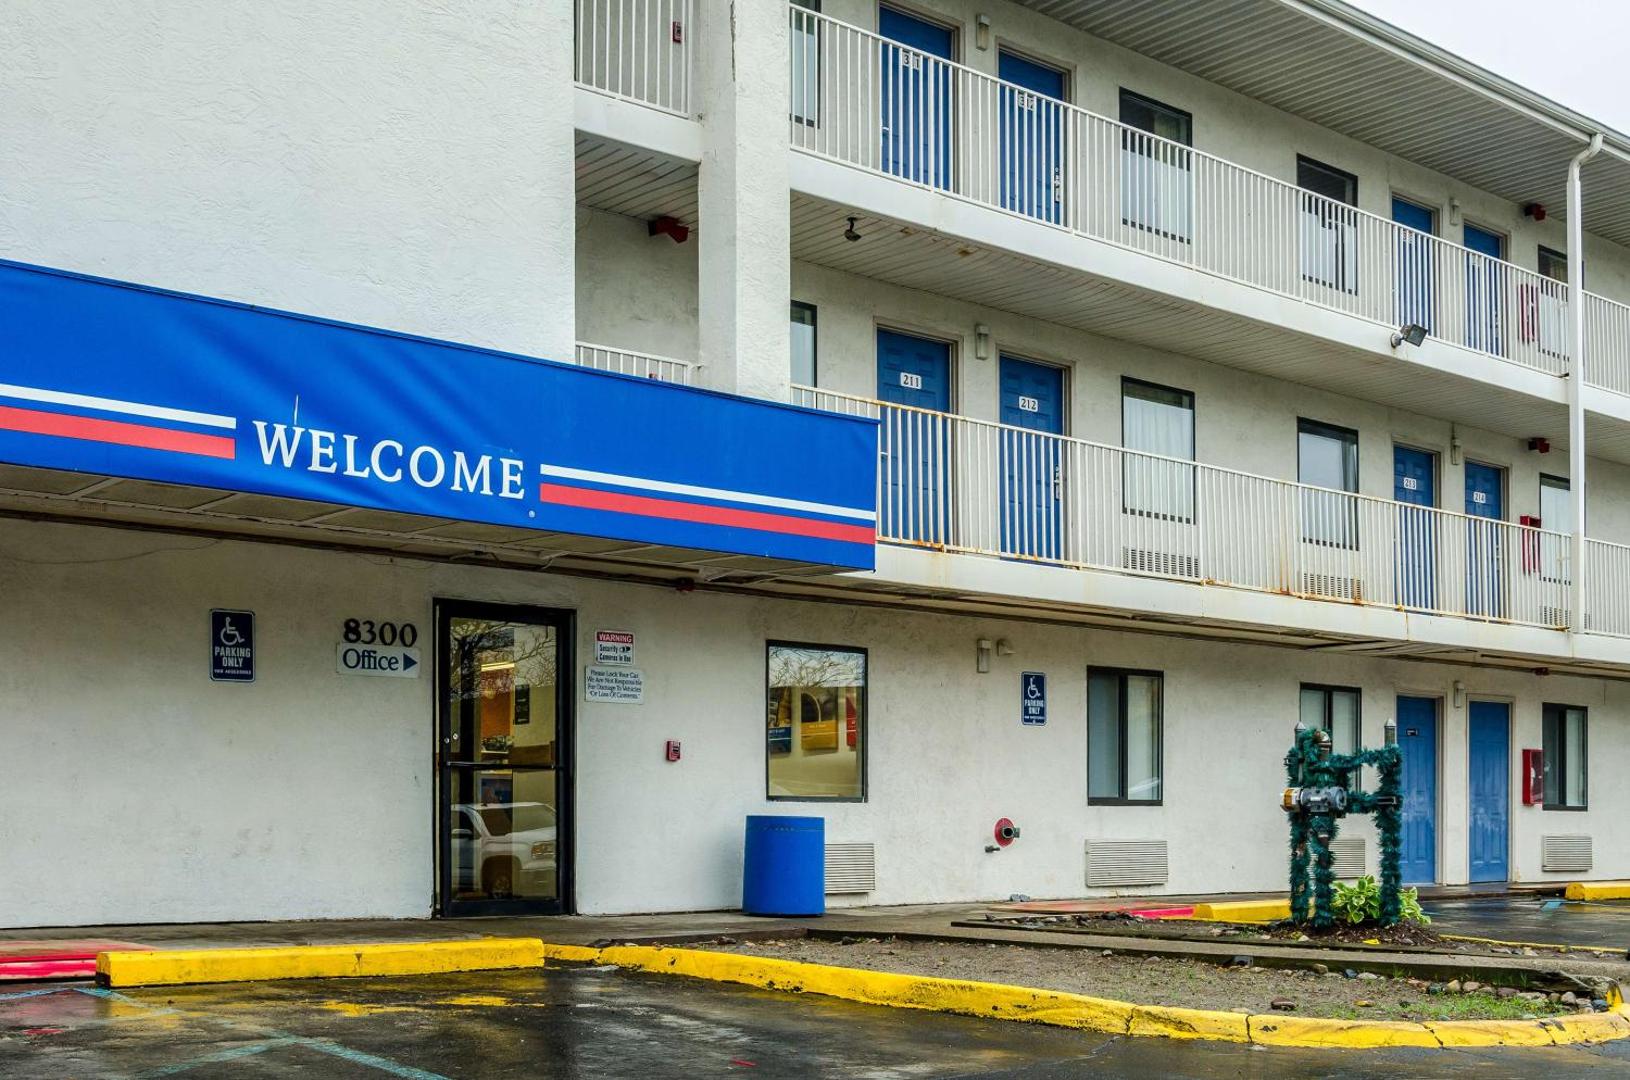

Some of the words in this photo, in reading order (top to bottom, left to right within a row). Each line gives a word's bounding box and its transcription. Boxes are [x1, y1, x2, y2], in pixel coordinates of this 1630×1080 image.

[903, 374, 919, 388] 211
[1020, 398, 1037, 410] 212
[252, 420, 526, 500] WELCOME
[343, 618, 418, 648] 8300
[599, 633, 632, 643] WARNING
[214, 646, 251, 658] PARKING
[600, 644, 618, 653] Security
[222, 656, 244, 667] ONLY
[342, 648, 399, 671] Office
[600, 653, 617, 661] Cameras
[1025, 699, 1043, 707] PARKING
